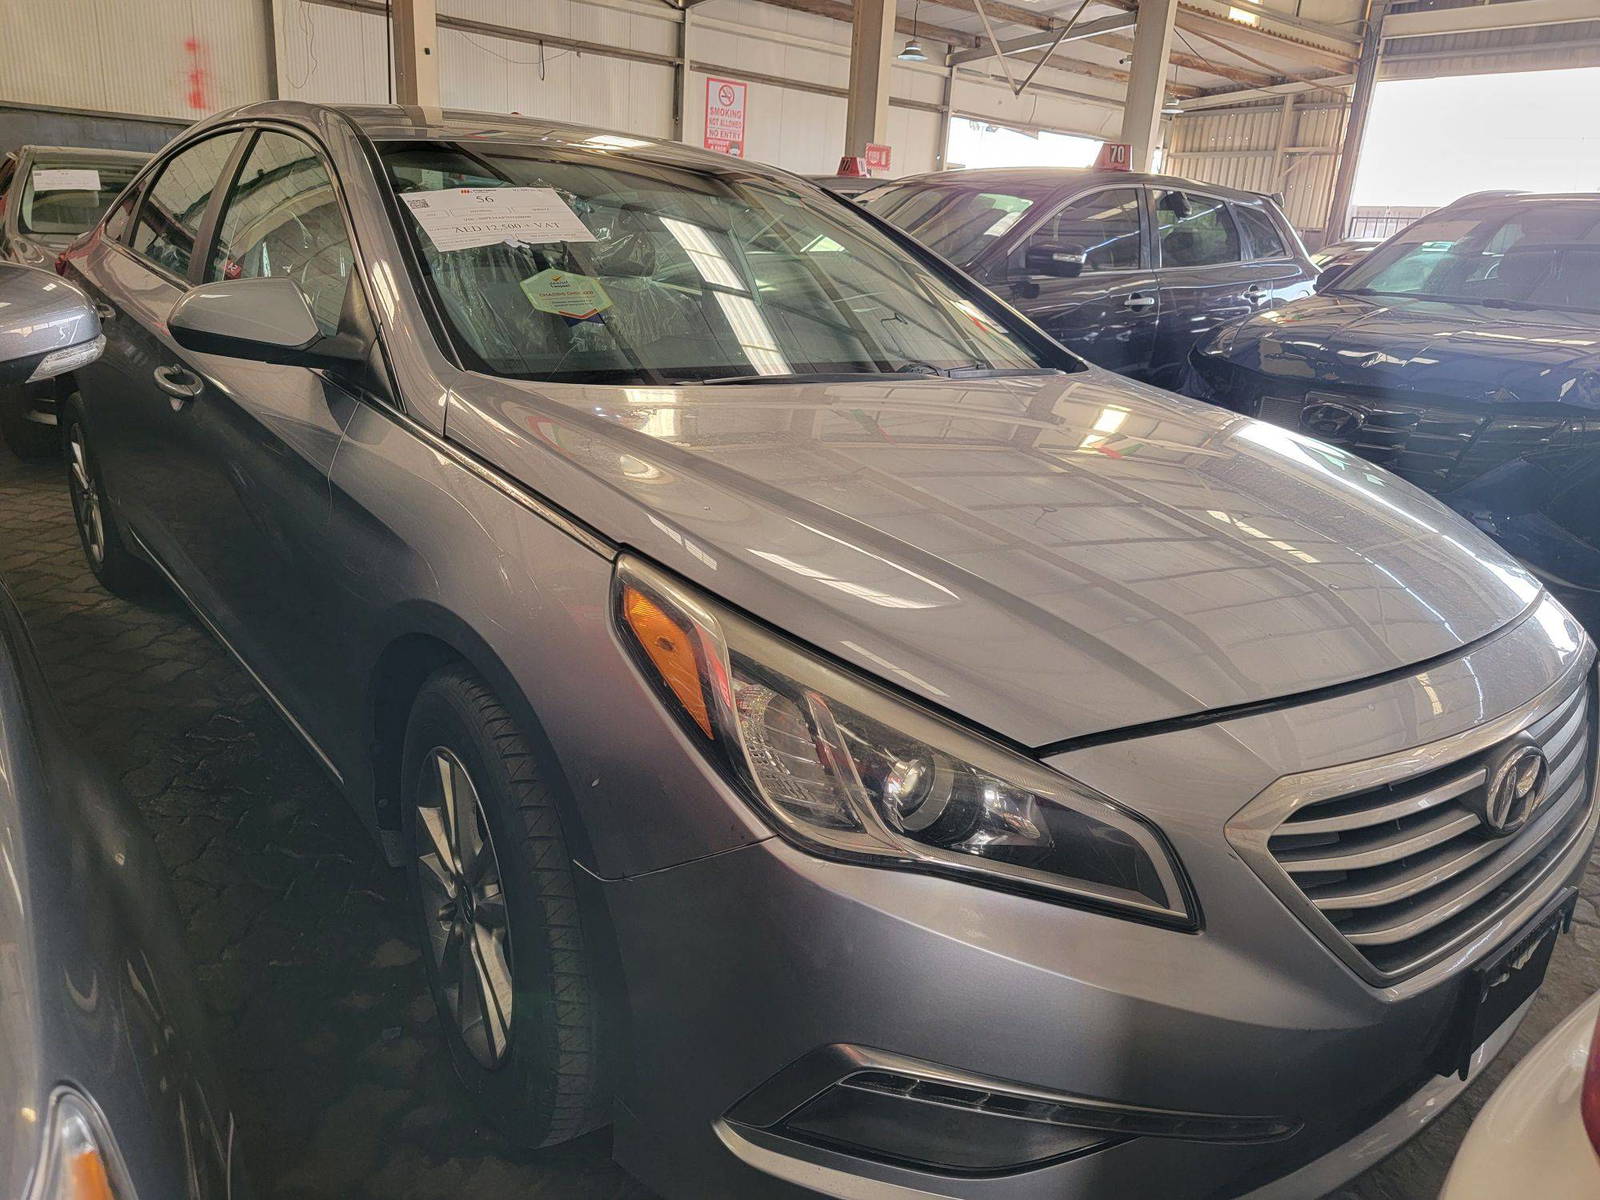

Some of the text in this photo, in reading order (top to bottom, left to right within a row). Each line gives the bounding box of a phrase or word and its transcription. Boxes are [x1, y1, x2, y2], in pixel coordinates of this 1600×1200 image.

[710, 107, 742, 118] SMOKING
[708, 118, 742, 128] NOT ALLOWED
[708, 129, 740, 139] NO ENTRY
[1111, 146, 1125, 163] 70
[475, 195, 494, 203] 56
[455, 225, 482, 233] AED
[485, 222, 522, 232] 12,500
[533, 221, 561, 230] VAT
